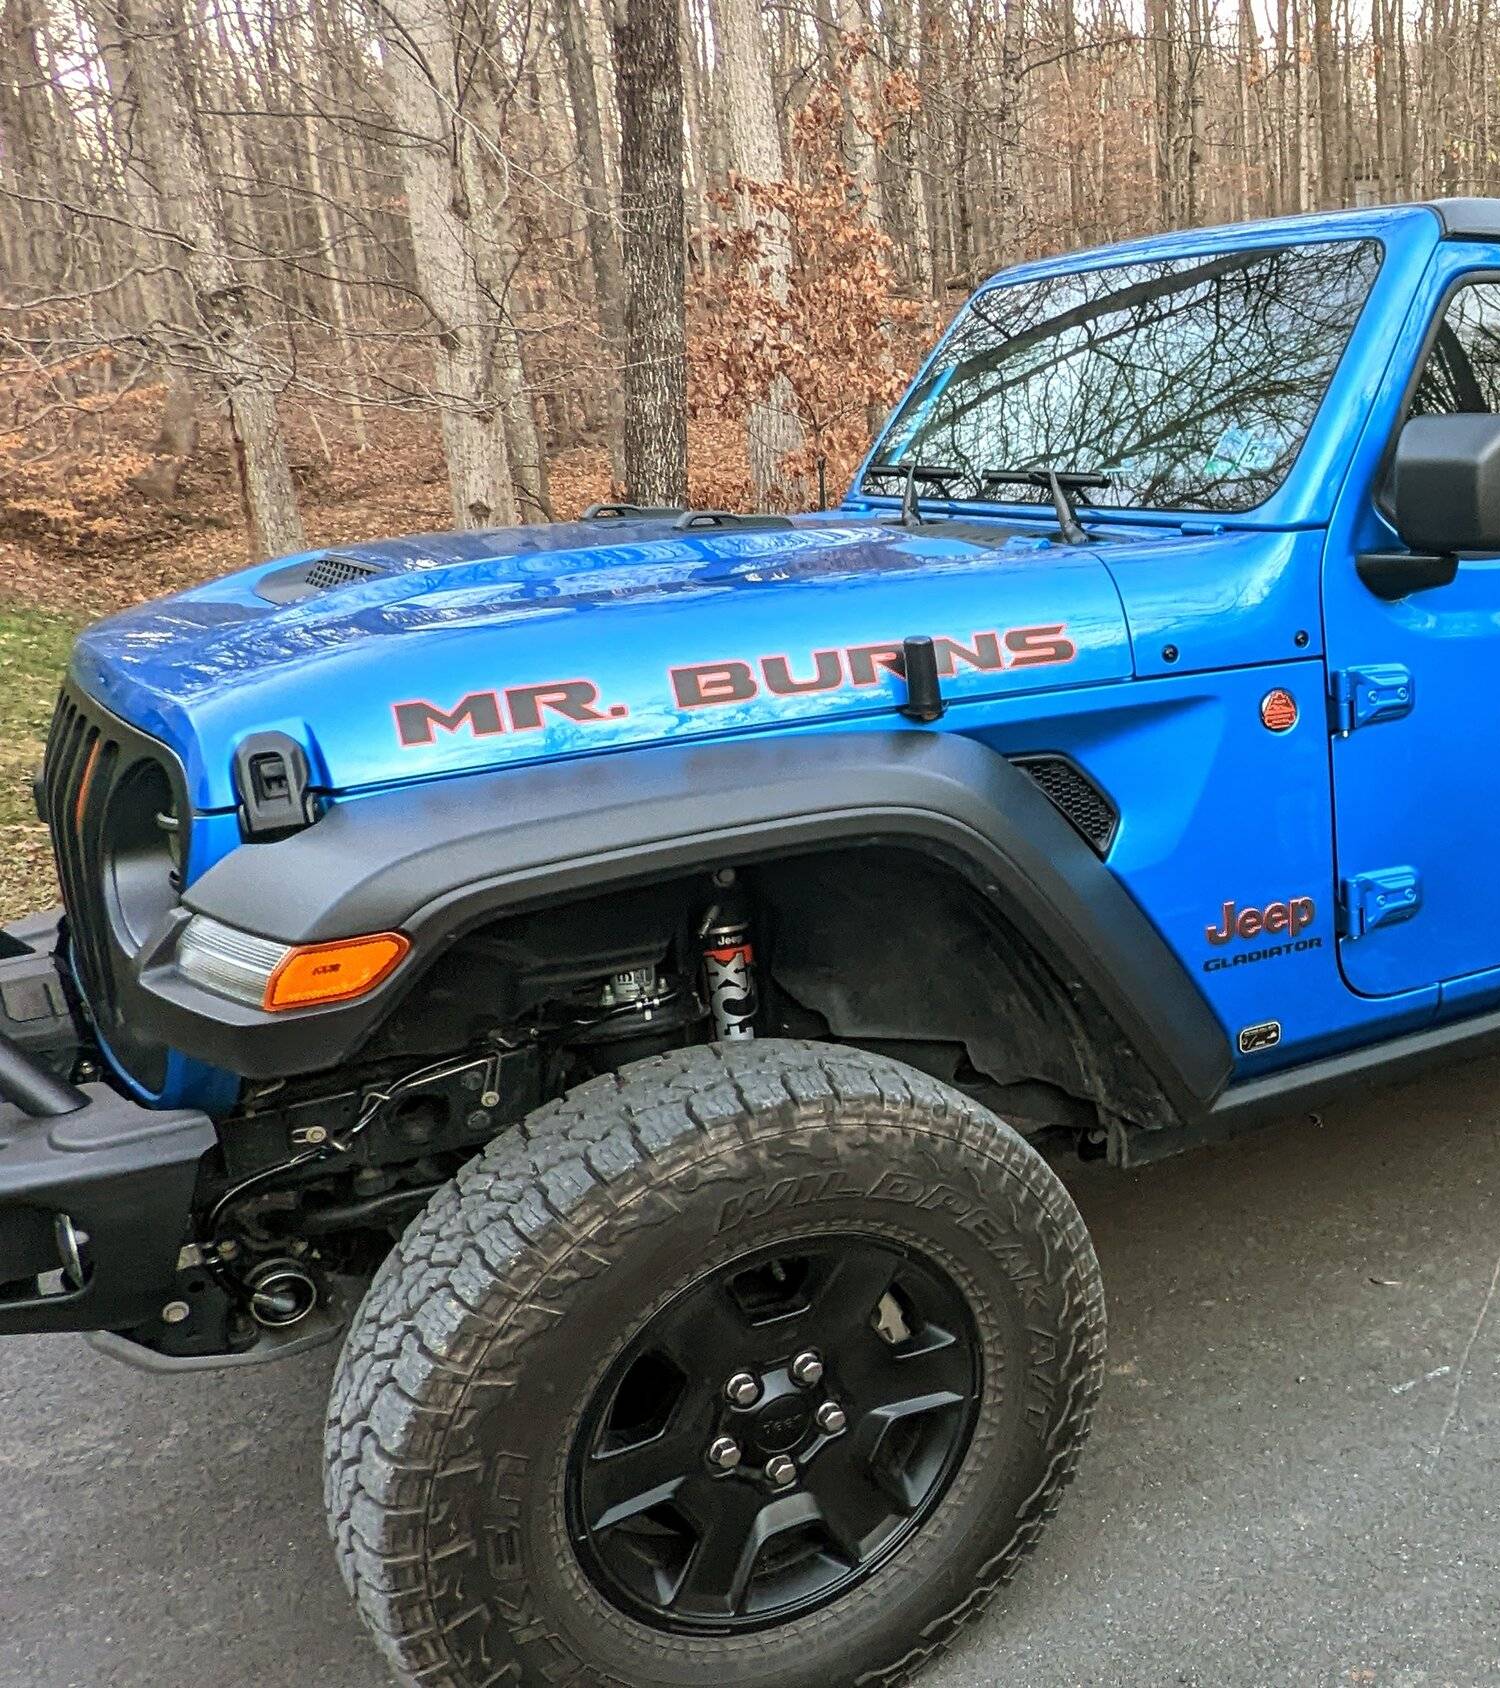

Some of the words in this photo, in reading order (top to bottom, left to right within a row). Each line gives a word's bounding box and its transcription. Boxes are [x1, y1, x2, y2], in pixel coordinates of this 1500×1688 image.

[391, 679, 628, 748] MR.
[668, 623, 1077, 709] BURNS
[1202, 937, 1323, 973] GLADIATOR
[1206, 895, 1316, 946] Jeep
[714, 1171, 1048, 1311] WILDPEAK
